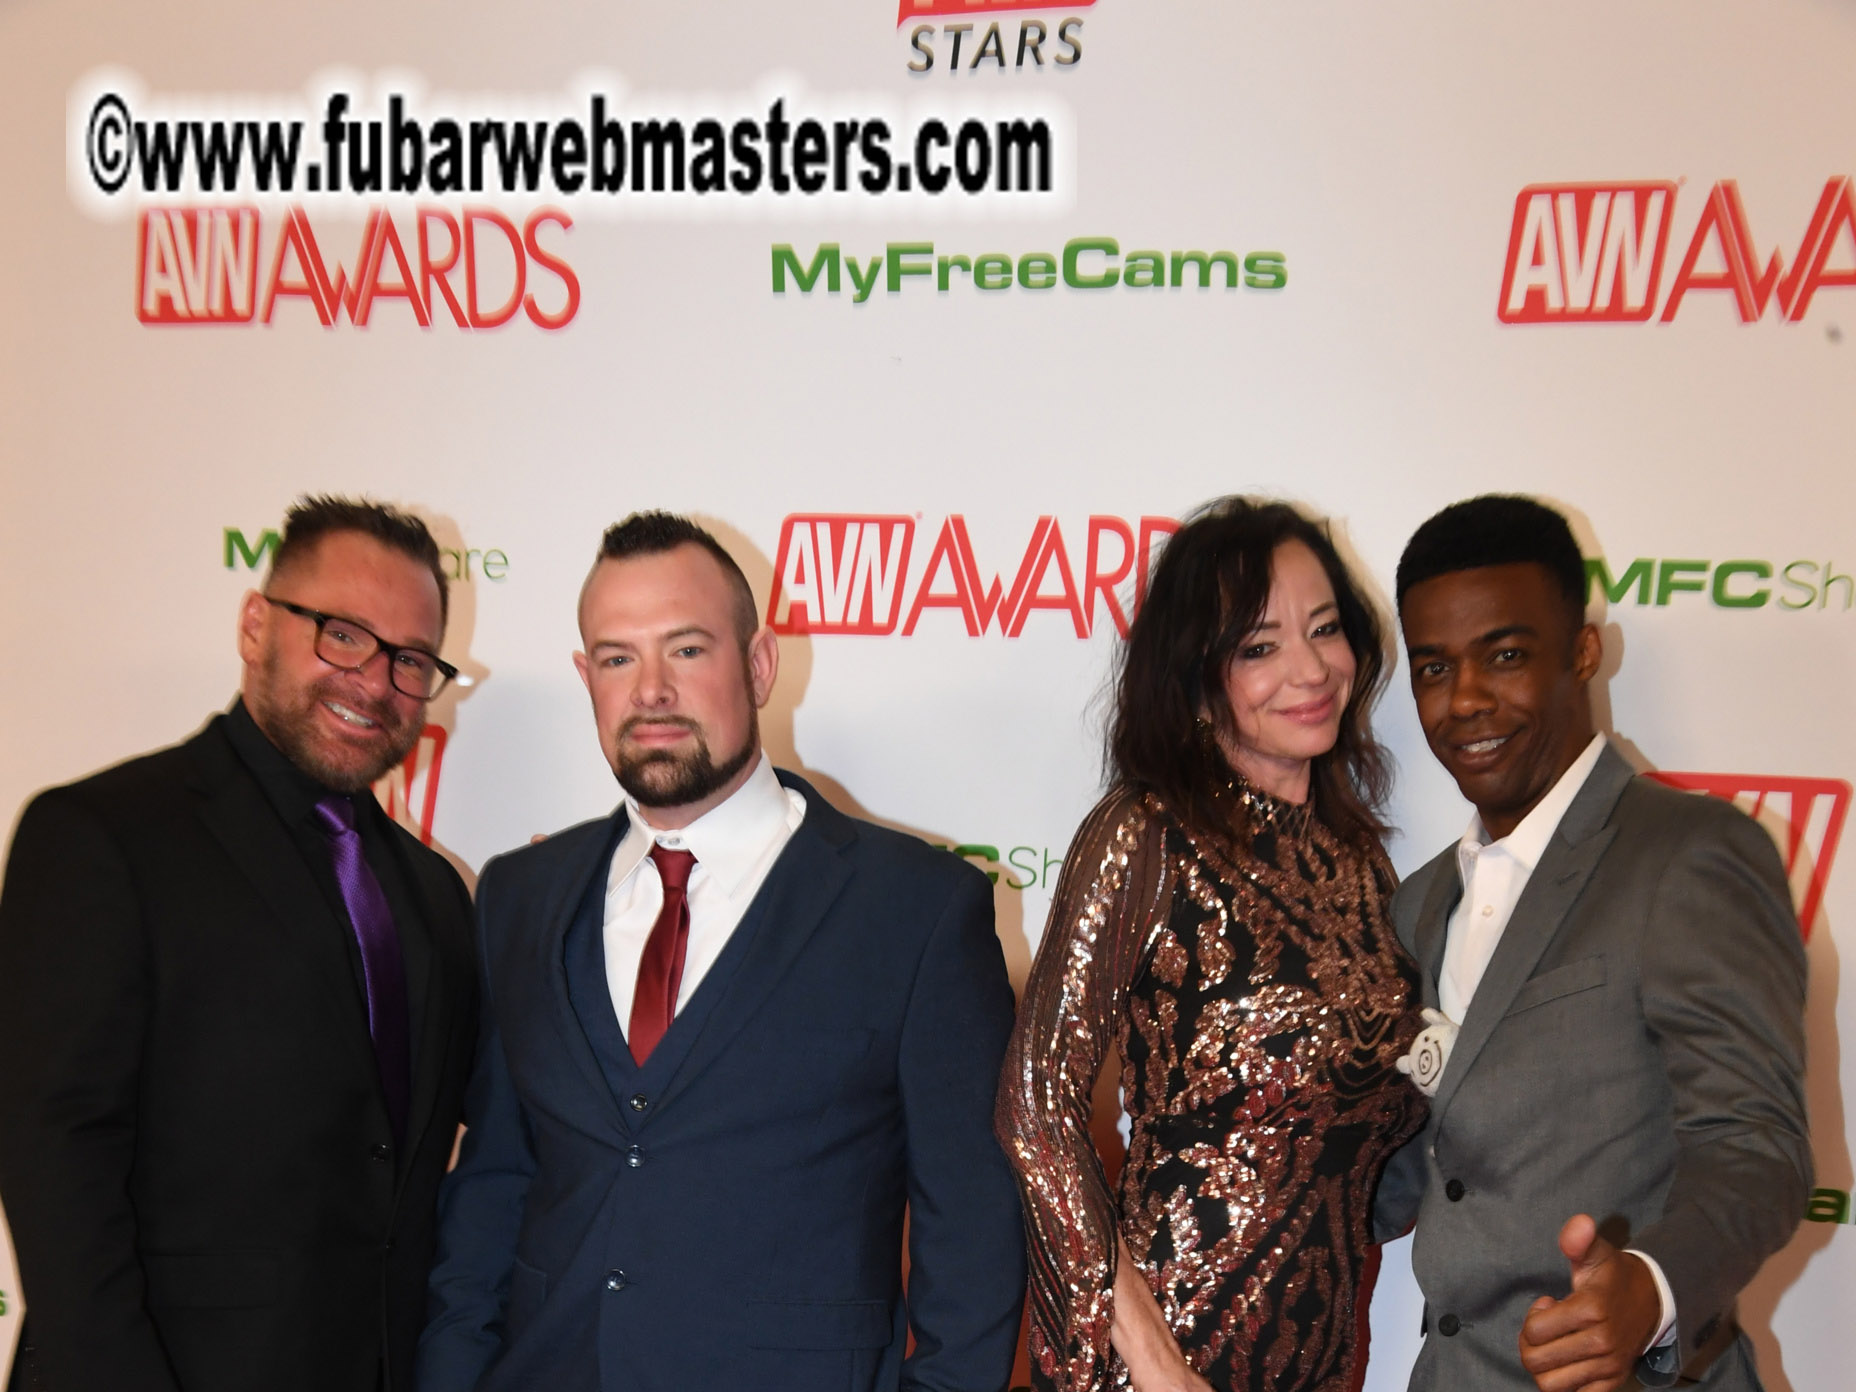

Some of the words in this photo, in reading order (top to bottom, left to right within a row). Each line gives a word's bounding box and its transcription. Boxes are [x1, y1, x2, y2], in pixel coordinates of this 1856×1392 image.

[906, 17, 1085, 73] STARS
[141, 206, 257, 322] AVN
[259, 205, 582, 332] AWARDS
[770, 236, 1289, 303] MyFreeCams
[1500, 184, 1673, 320] AVN
[1658, 174, 1856, 324] AWA
[771, 517, 911, 632] AVN
[901, 513, 1184, 640] AWAR
[1583, 556, 1856, 610] MFCSh
